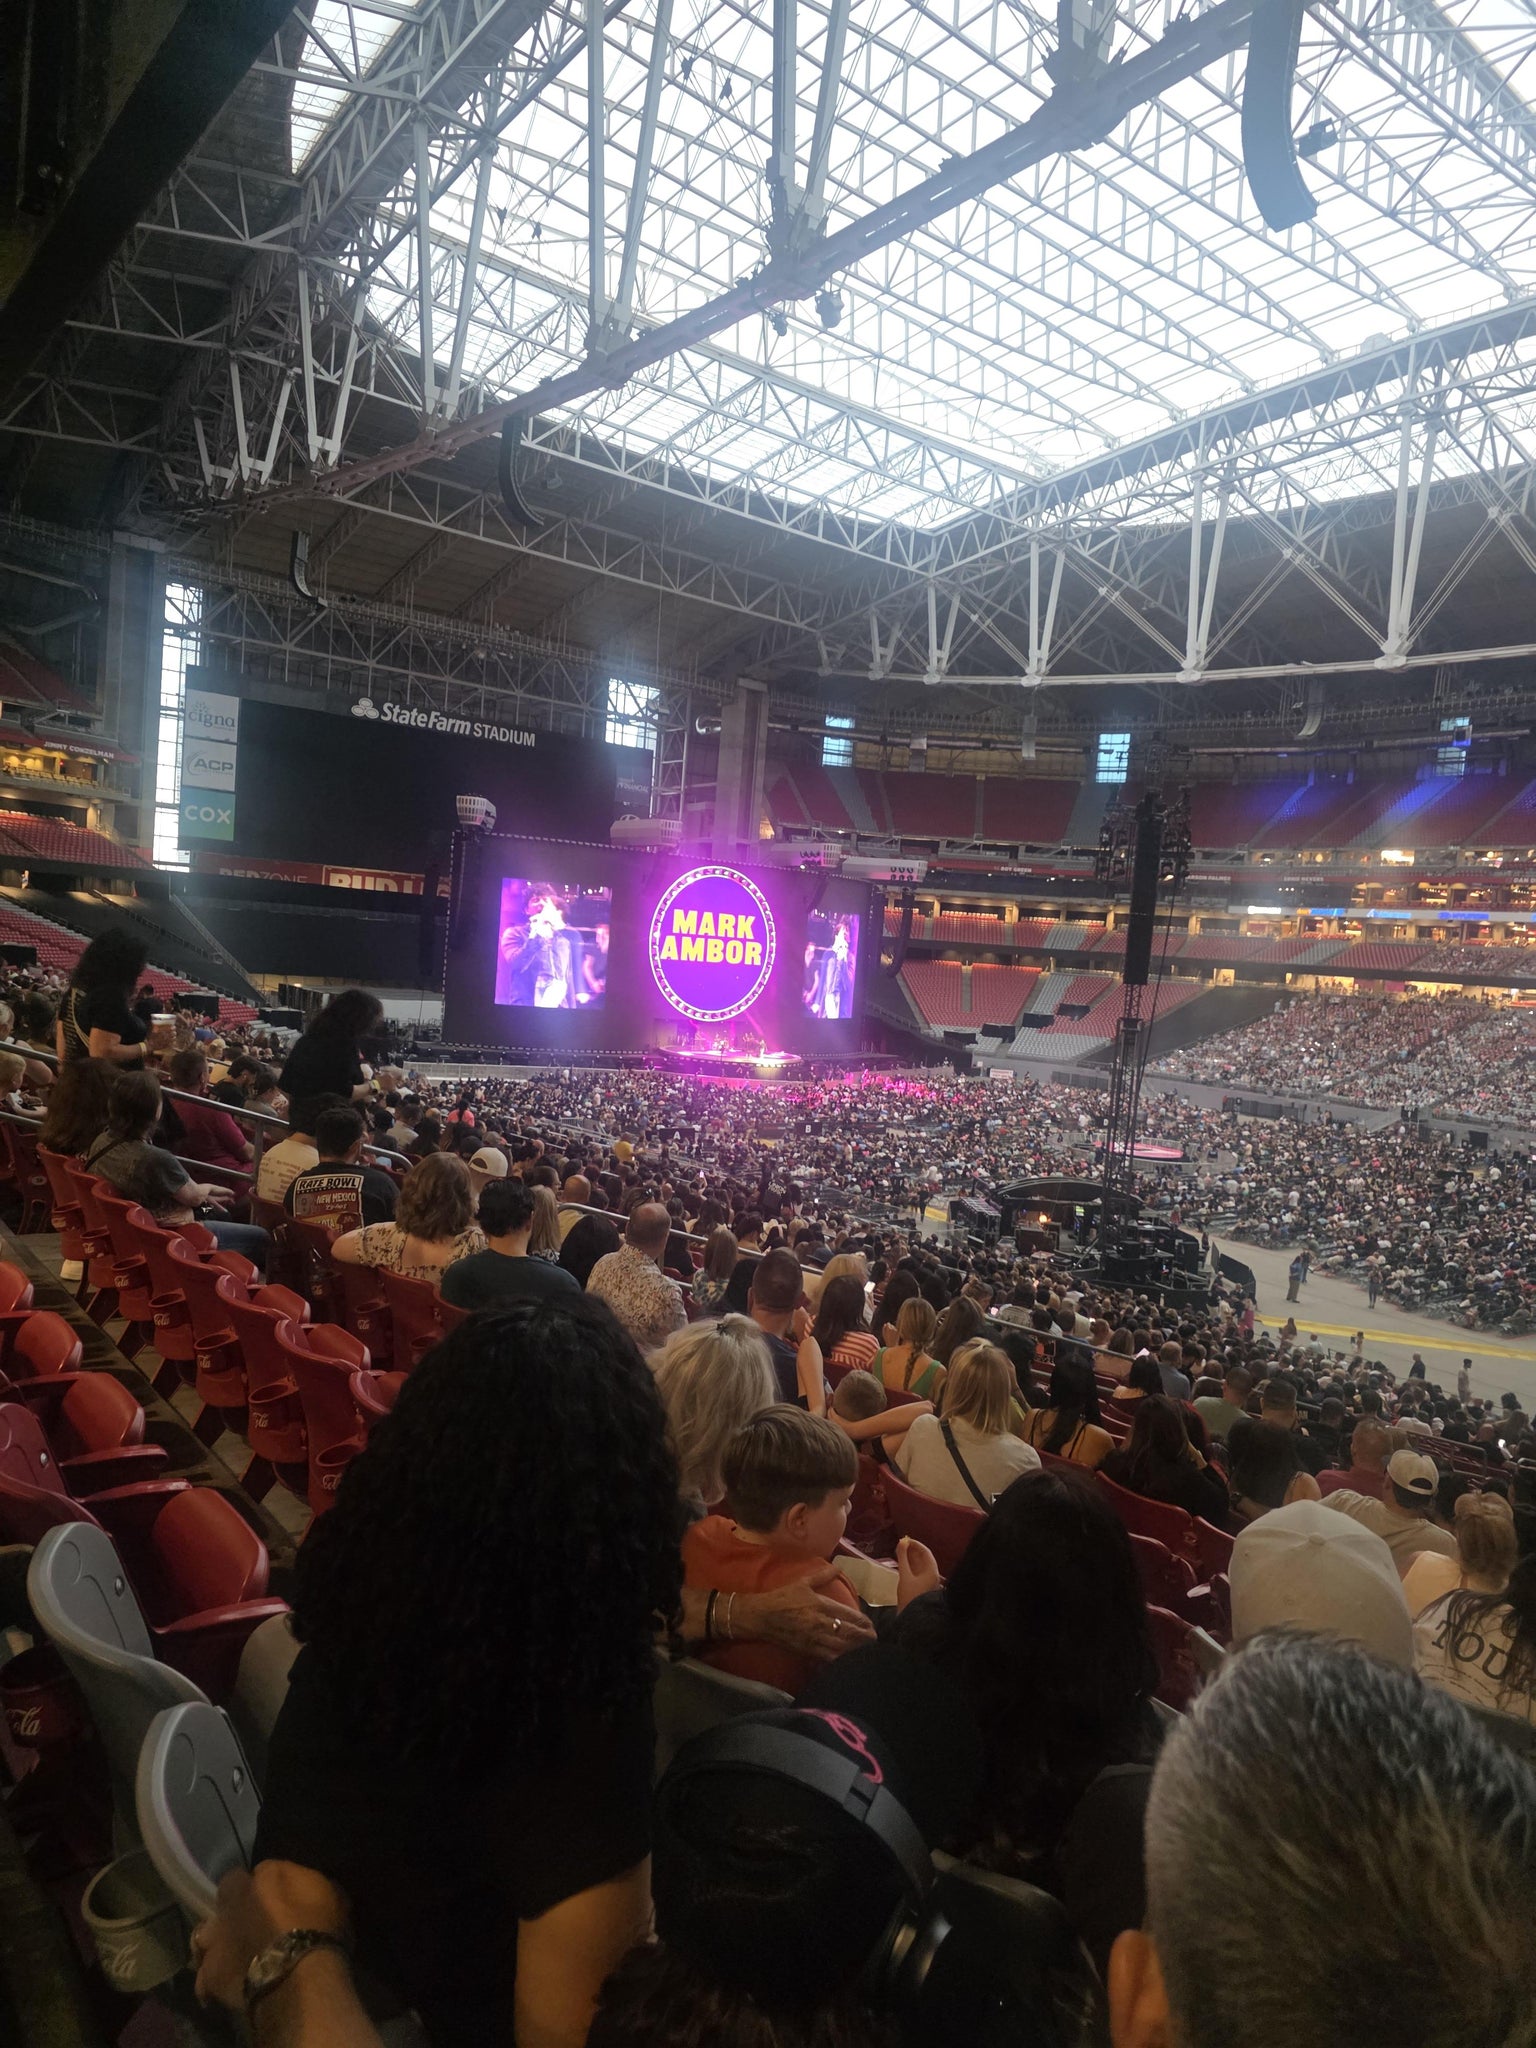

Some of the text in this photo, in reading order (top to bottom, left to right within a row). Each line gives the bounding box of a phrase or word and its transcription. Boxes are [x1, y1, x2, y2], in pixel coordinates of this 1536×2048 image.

[188, 709, 236, 728] cigna
[473, 722, 536, 748] STADIUM
[43, 741, 115, 759] JIMMY CONZELMAN
[193, 758, 234, 771] ACP
[184, 804, 231, 825] COX
[672, 908, 756, 940] MARK
[660, 935, 763, 966] AMBOR
[673, 1130, 681, 1140] A
[805, 1124, 812, 1133] B
[299, 1177, 357, 1190] RATE BOWL
[316, 1192, 356, 1204] NEW MEXICO
